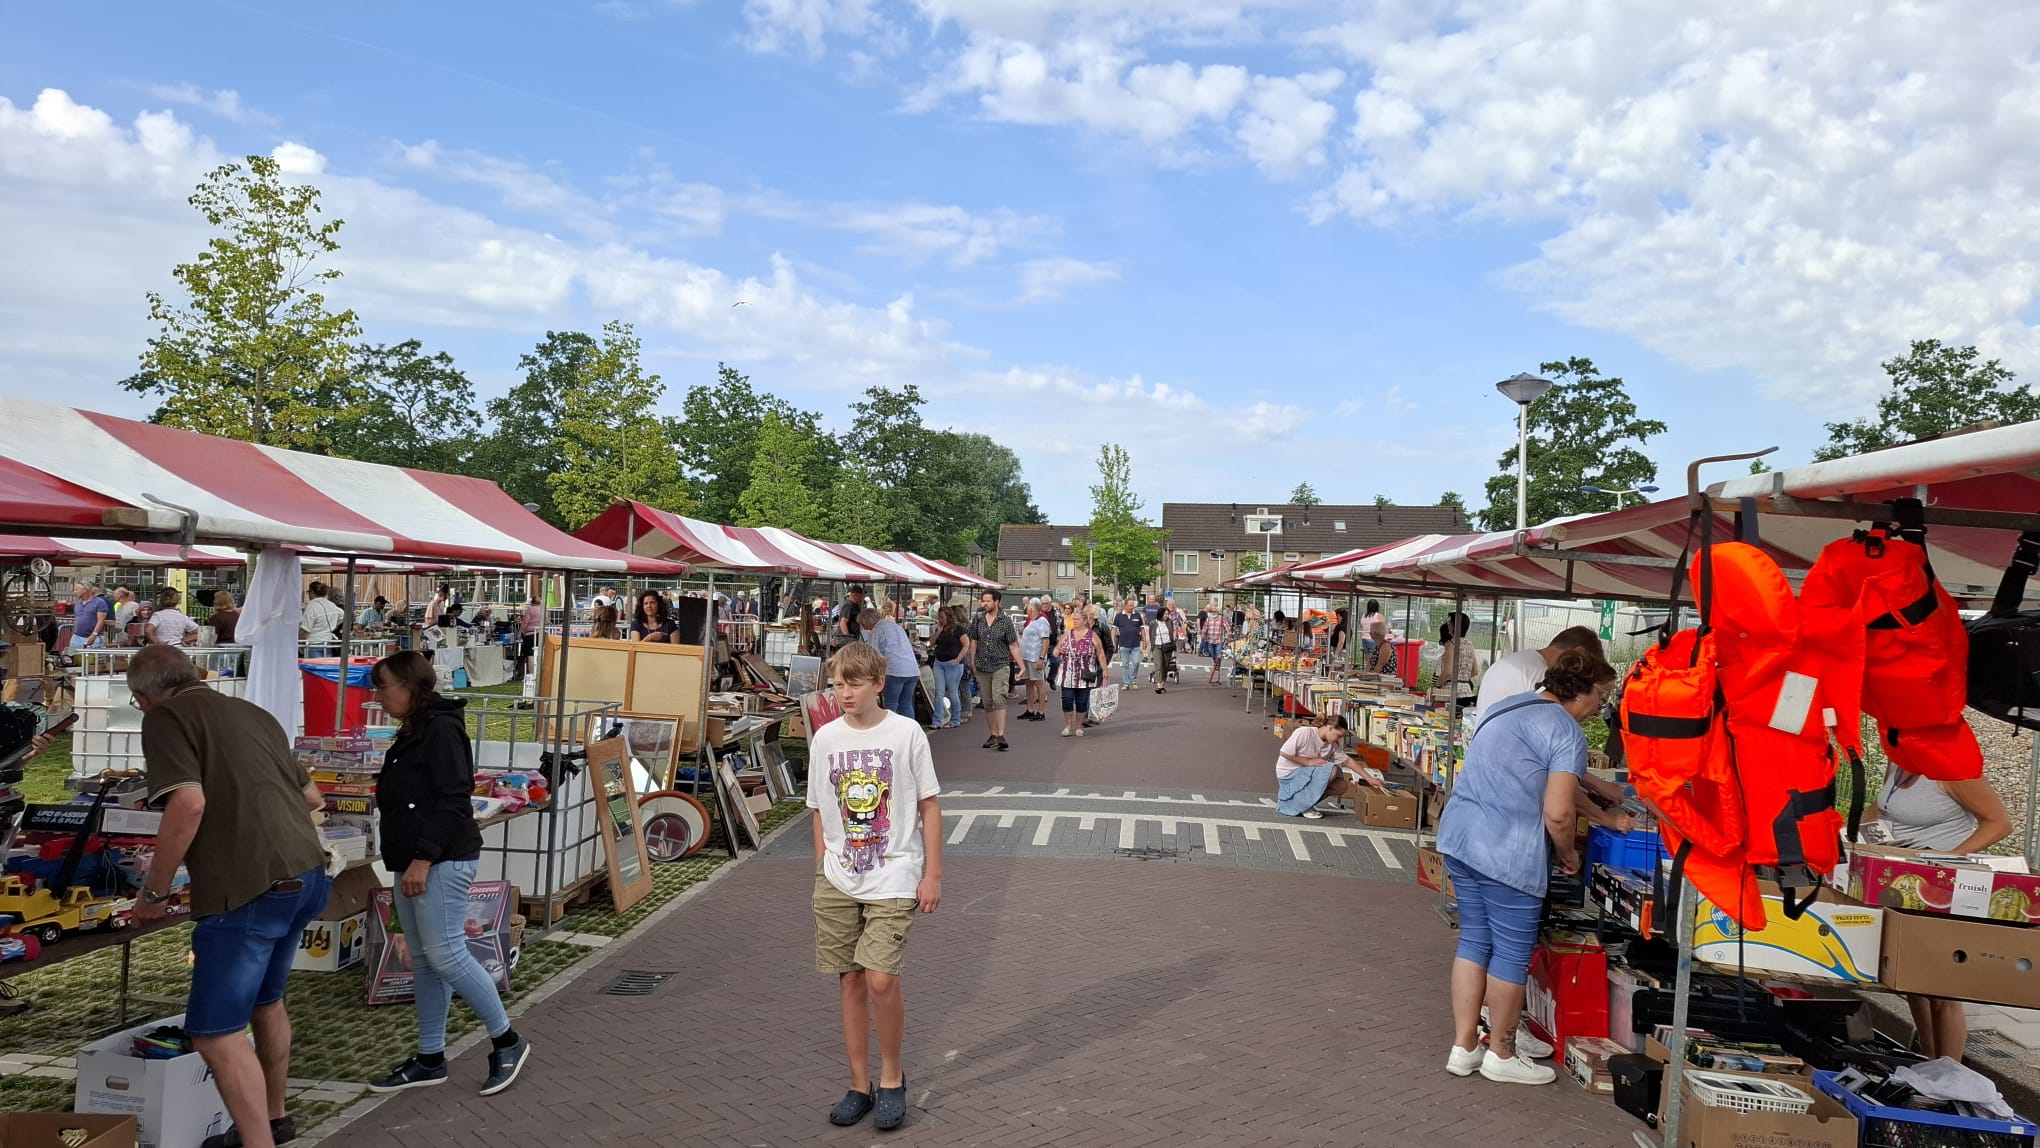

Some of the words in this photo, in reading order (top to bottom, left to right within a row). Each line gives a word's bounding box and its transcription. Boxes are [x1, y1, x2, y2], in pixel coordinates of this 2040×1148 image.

[828, 748, 893, 774] LIFE'S
[337, 800, 366, 812] VISION
[1958, 882, 1988, 893] fruish
